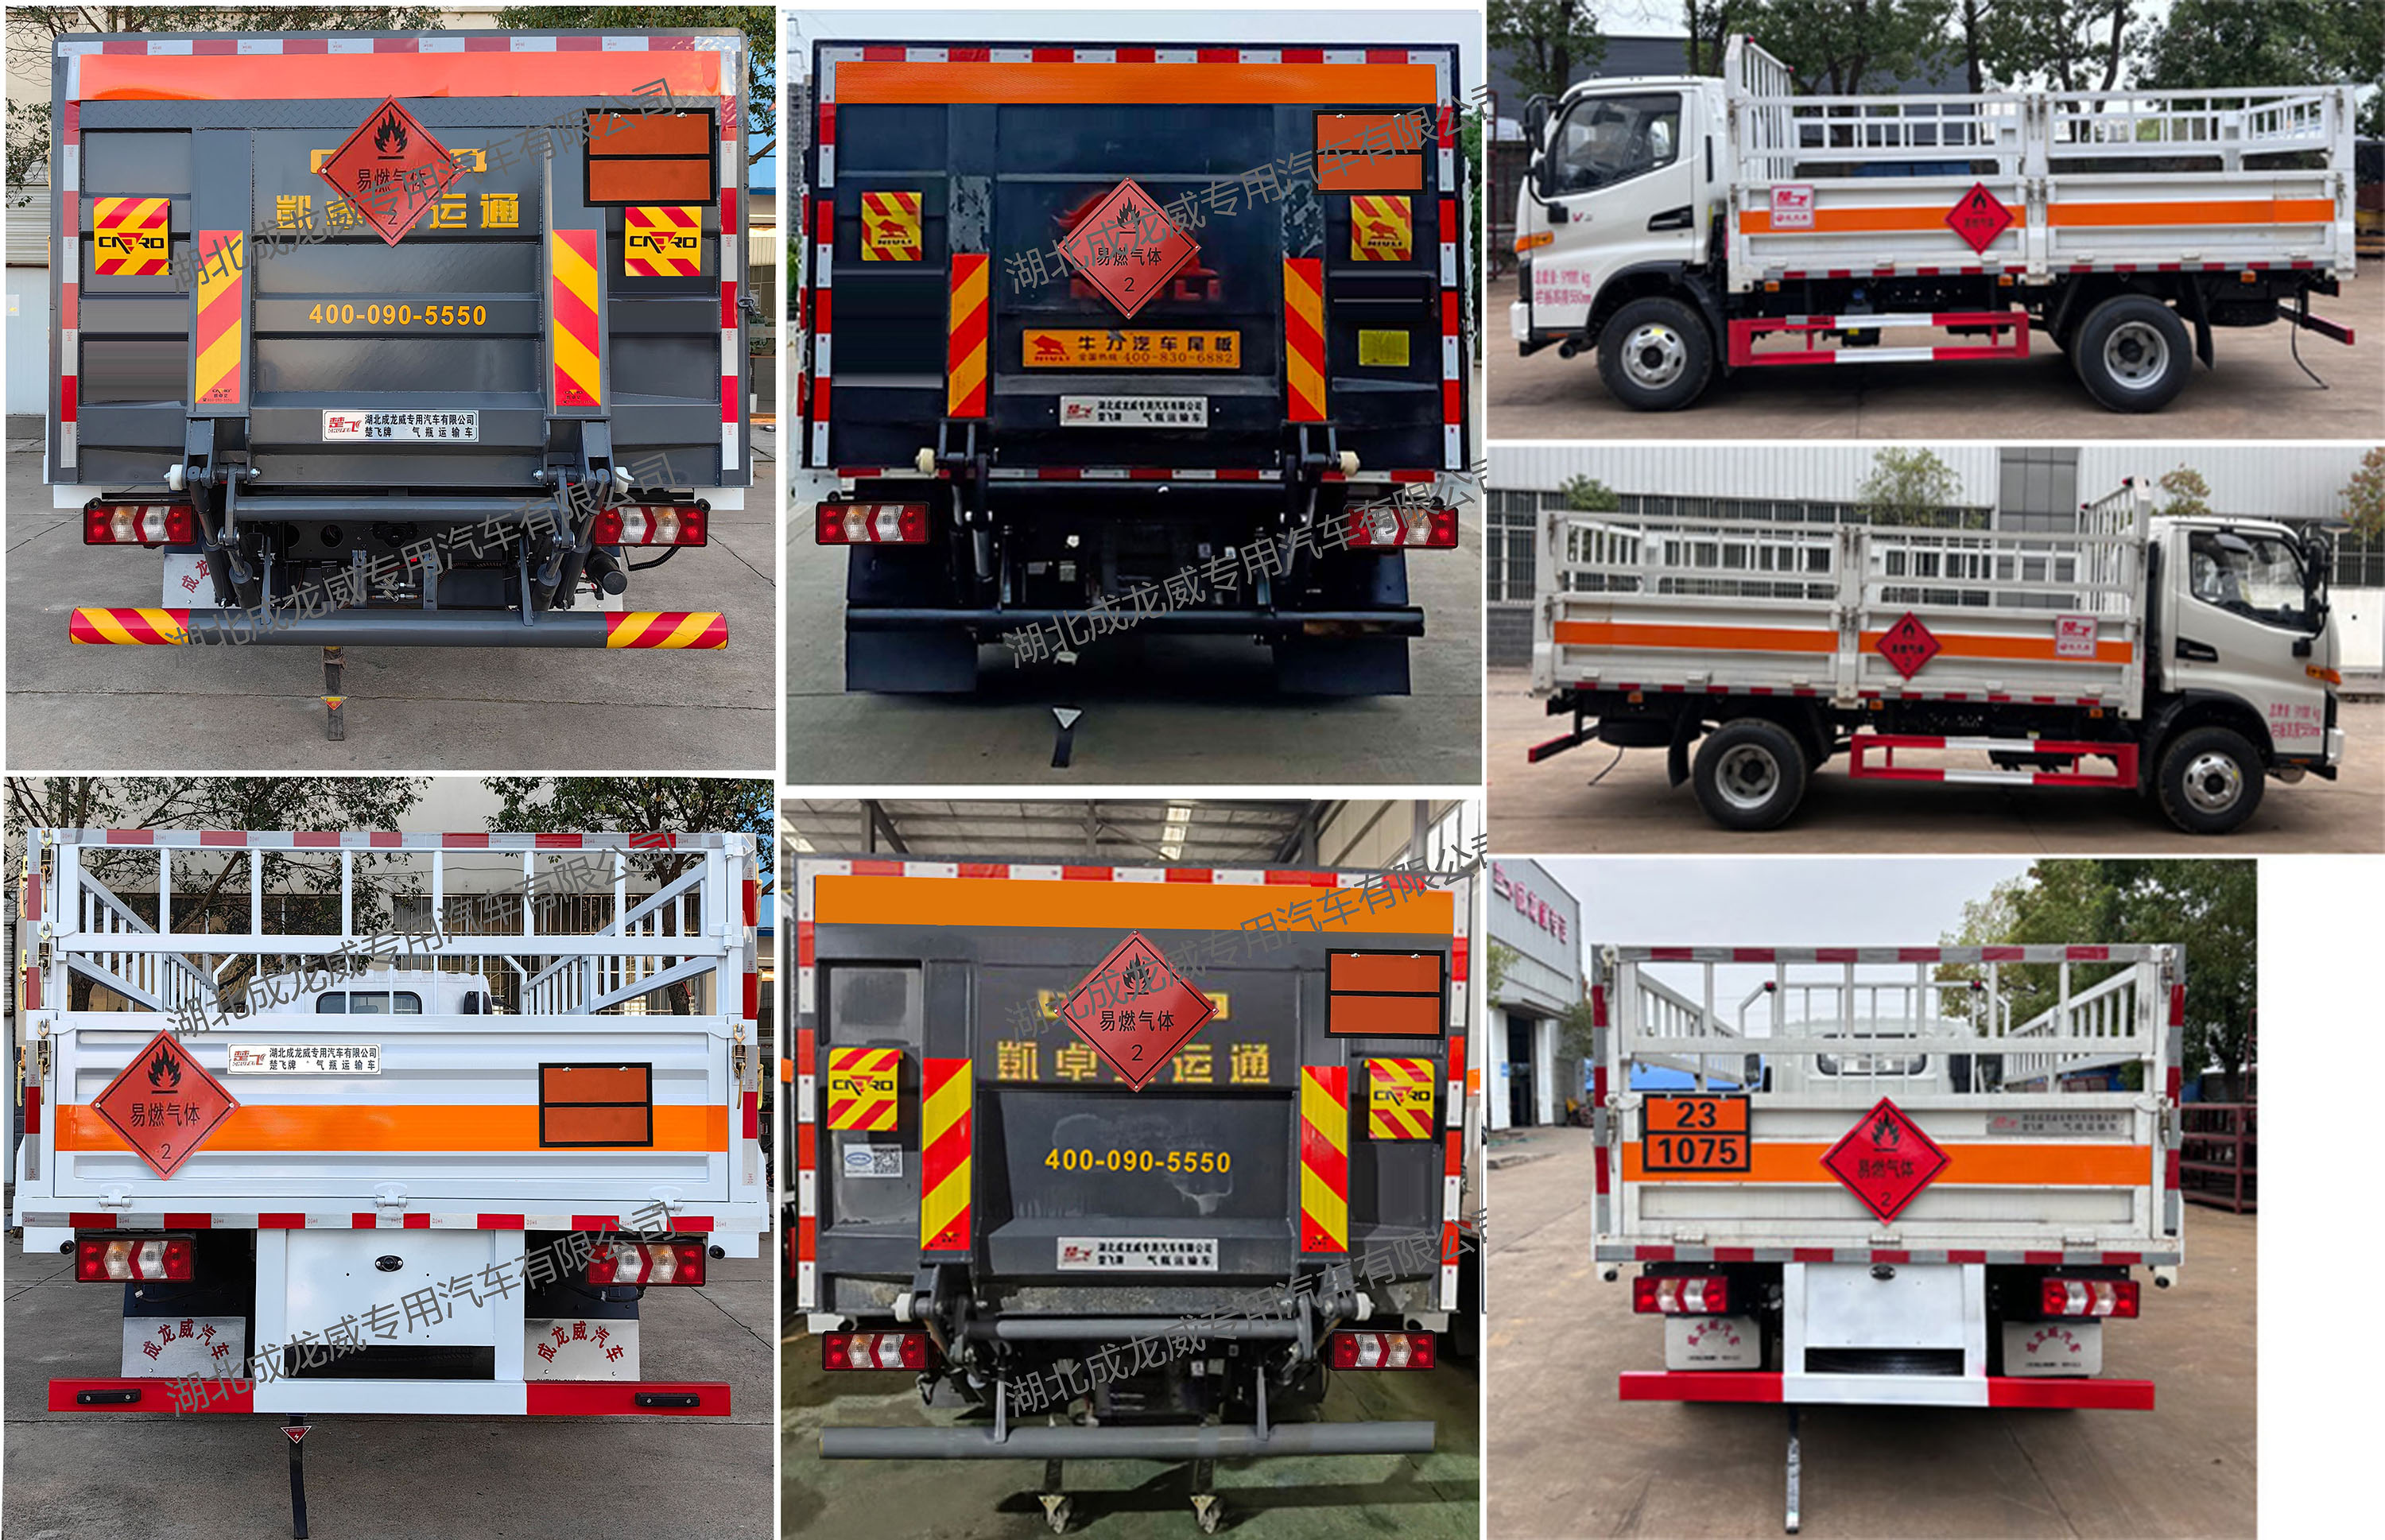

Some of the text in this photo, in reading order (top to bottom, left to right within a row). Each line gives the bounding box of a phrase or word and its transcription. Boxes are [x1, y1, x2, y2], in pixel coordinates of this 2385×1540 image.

[357, 169, 427, 192] 易燃气体
[1096, 247, 1161, 266] 易燃气体
[1124, 277, 1134, 292] 2
[309, 304, 487, 326] 400-090-5550
[364, 413, 475, 425] 湖北成龙威专用汽车有限公司
[364, 427, 473, 438] 楚飞牌 气瓶运输车
[1099, 1010, 1175, 1032] 易燃气体
[270, 1047, 377, 1058] 湖北成龙威专用汽车有限公司
[1131, 1044, 1143, 1061] 2
[270, 1060, 375, 1071] 楚飞牌 气瓶运输车
[130, 1103, 200, 1127] 易燃气体
[1677, 1101, 1716, 1127] 23
[161, 1143, 171, 1159] 2
[1045, 1148, 1231, 1173] 400-090-5550
[1658, 1138, 1737, 1164] 1075
[1880, 1192, 1891, 1207] 2
[143, 1318, 229, 1361] 成龙威汽车
[537, 1321, 624, 1364] 成龙威汽车
